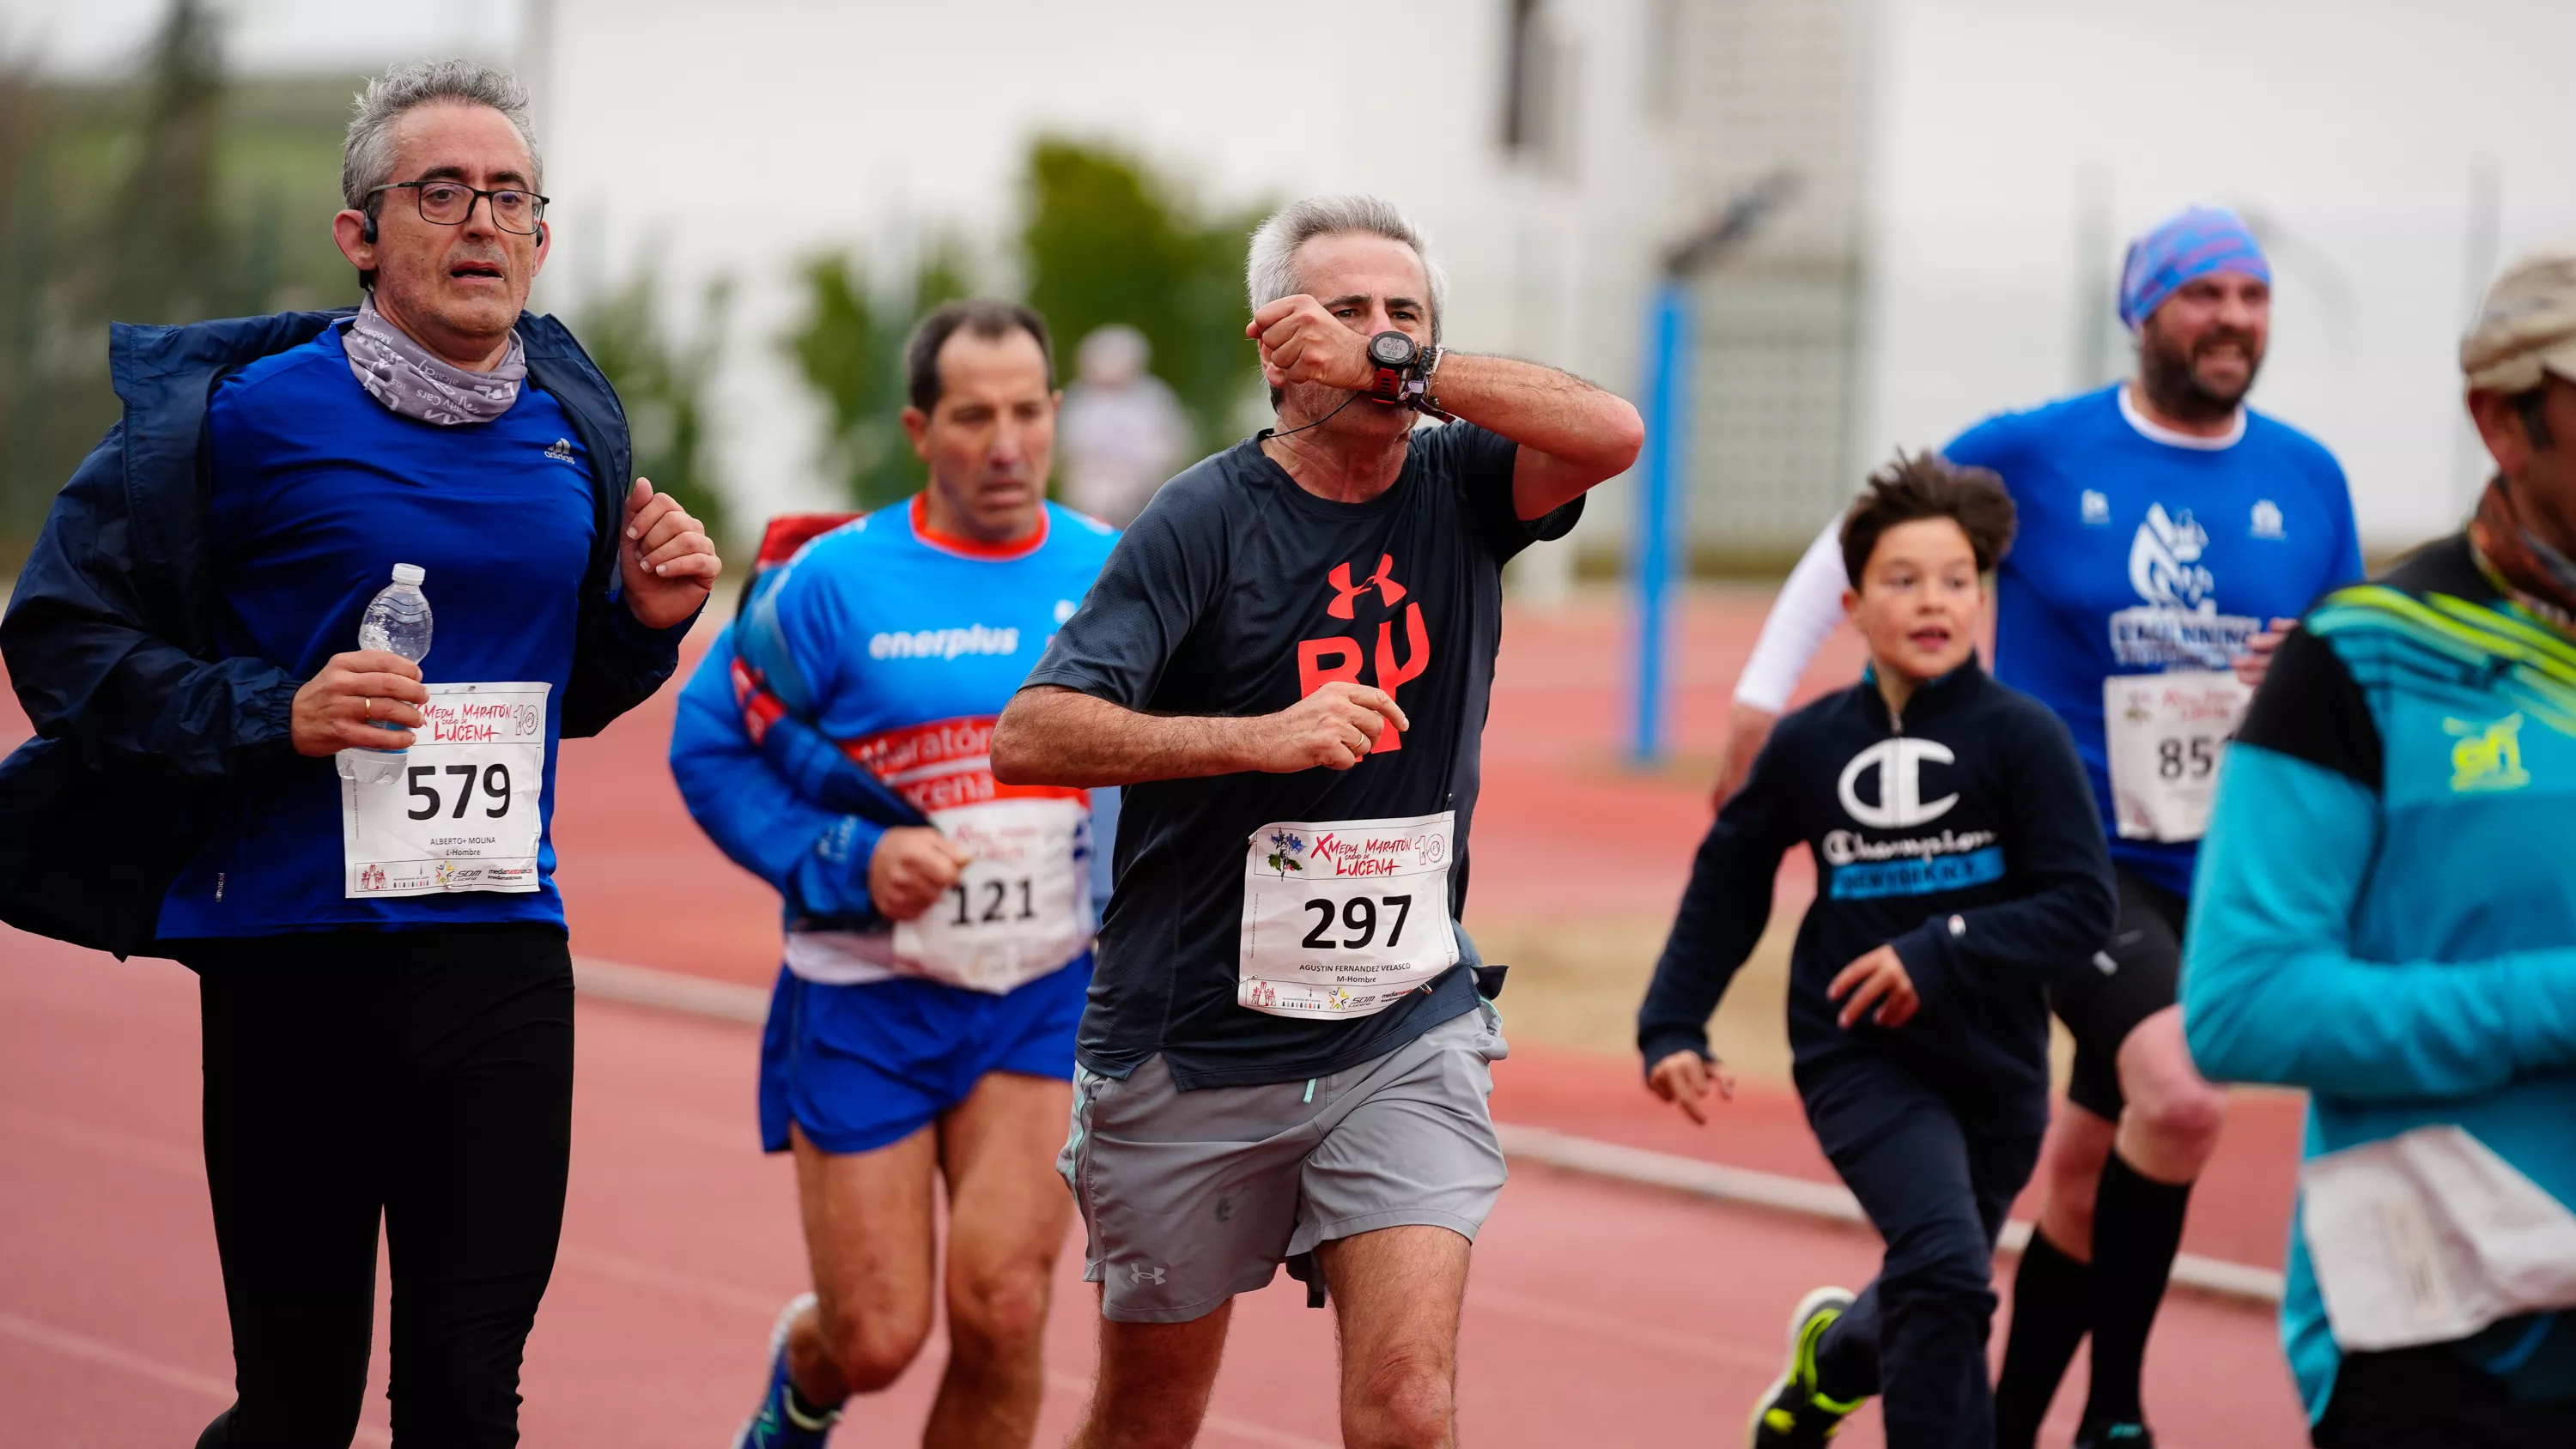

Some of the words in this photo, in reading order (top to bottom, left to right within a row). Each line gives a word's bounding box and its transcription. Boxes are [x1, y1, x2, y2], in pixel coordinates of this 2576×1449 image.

[416, 389, 441, 406] Cars
[544, 451, 574, 464] adidas
[869, 623, 1019, 661] enerplus
[462, 704, 512, 719] MARATÓN
[434, 721, 502, 743] LUCENA
[2159, 736, 2236, 781] 85
[407, 763, 511, 821] 579
[430, 837, 466, 846] ALBERTO+
[468, 836, 496, 845] MOLINA
[1365, 837, 1413, 854] MARATÓN
[1822, 828, 1997, 866] Champion
[1336, 857, 1401, 876] LUCENA
[950, 876, 1037, 927] 121
[1302, 894, 1412, 949] 297
[1299, 963, 1334, 973] AGUSTIN
[1335, 964, 1380, 973] FERNANDEZ
[1381, 962, 1411, 972] VELASCO
[1336, 975, 1376, 984] M-Hombre
